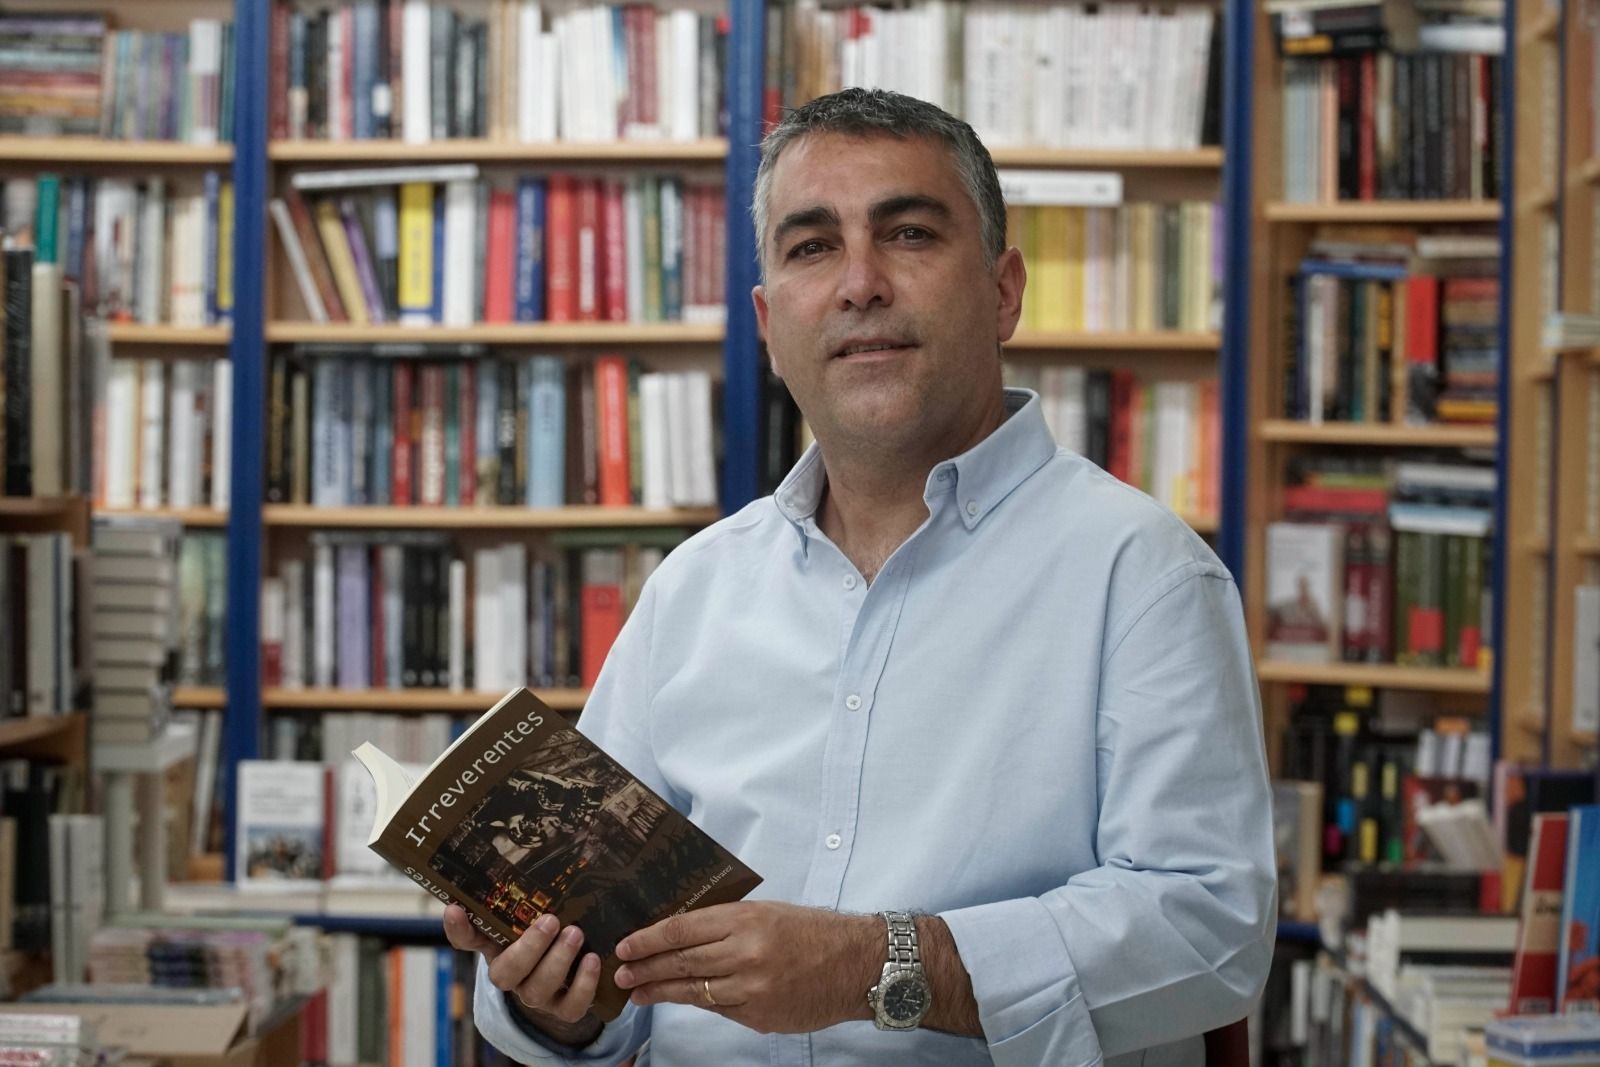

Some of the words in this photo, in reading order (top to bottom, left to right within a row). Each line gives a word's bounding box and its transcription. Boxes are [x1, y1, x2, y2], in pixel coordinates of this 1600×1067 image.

[405, 711, 544, 847] Irreverentes
[404, 866, 510, 946] Irrevrentes
[685, 883, 712, 908] Andrada
